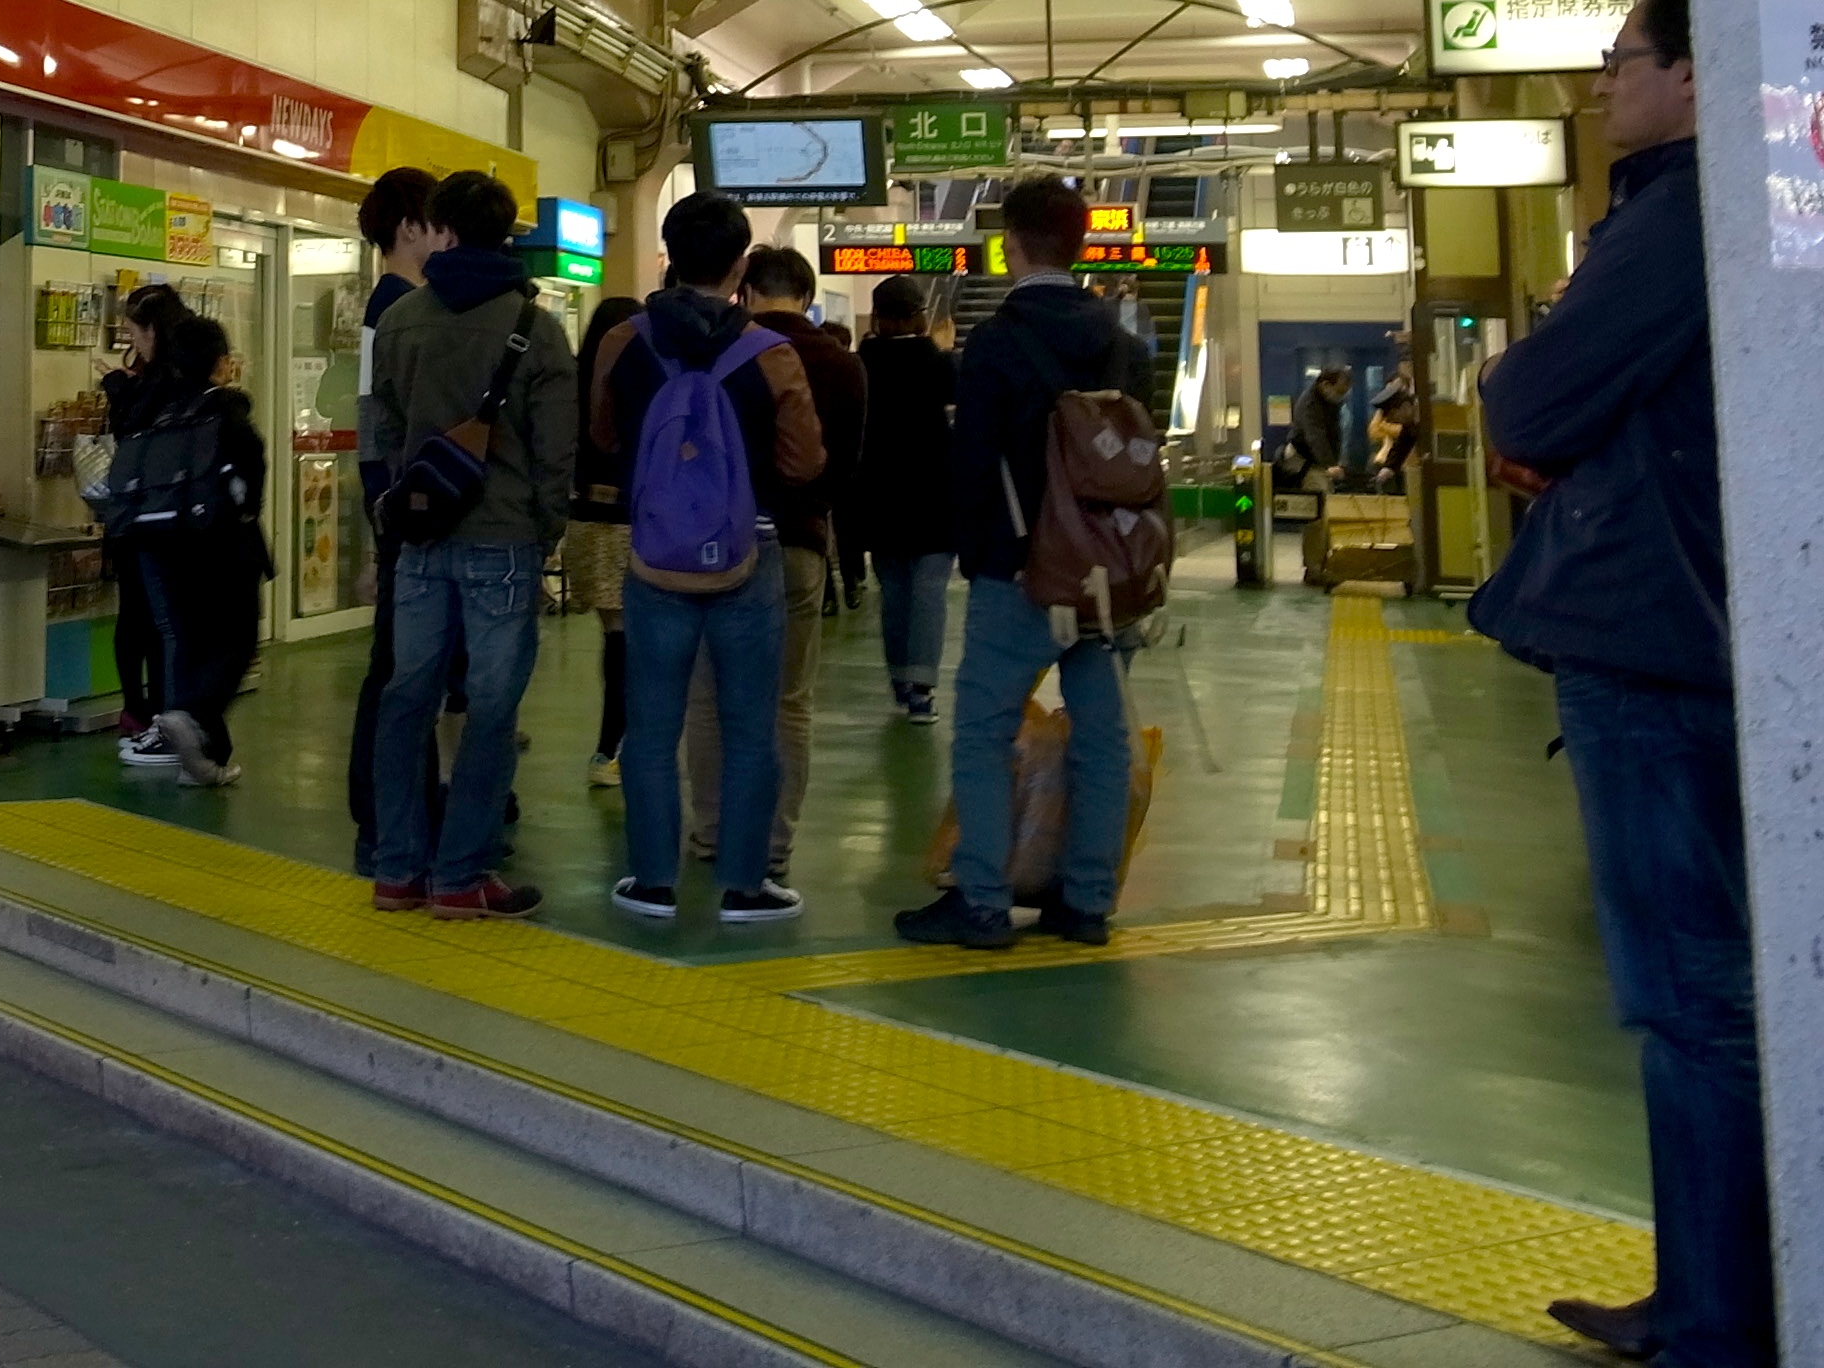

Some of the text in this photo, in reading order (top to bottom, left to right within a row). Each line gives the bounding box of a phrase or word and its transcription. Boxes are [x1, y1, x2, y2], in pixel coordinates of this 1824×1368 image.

[271, 94, 334, 150] NEWDAYS
[909, 111, 987, 139] 北口
[823, 223, 837, 241] 2
